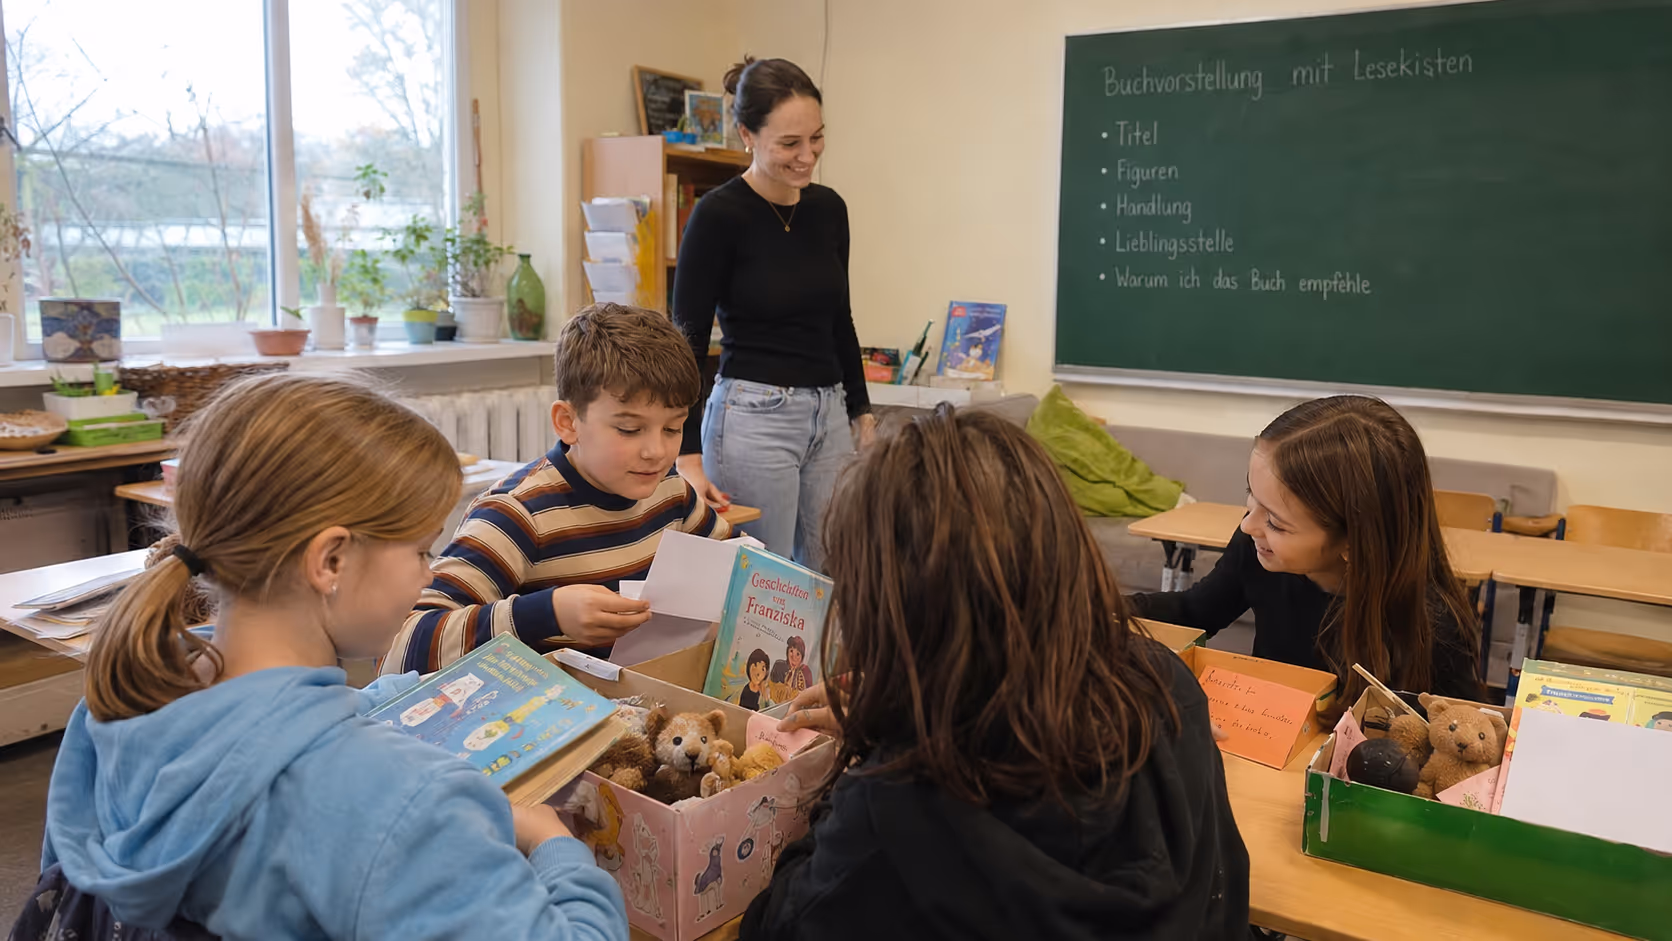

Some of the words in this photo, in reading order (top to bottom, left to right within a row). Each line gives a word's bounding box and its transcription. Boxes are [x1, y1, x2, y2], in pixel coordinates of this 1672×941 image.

[1104, 61, 1263, 100] Buchvorstellung
[1292, 53, 1334, 85] mit
[1354, 47, 1473, 80] Lesekisten
[1115, 120, 1158, 146] Titel
[1117, 158, 1179, 188] Figuren
[1116, 193, 1192, 224] Handlung
[1115, 228, 1234, 260] Lieblingsstelle
[1115, 266, 1169, 289] Warum
[1179, 267, 1201, 289] ich
[1212, 267, 1239, 290] das
[1251, 267, 1286, 291] Buch
[1298, 271, 1372, 300] empfehle
[745, 596, 805, 631] Franziska
